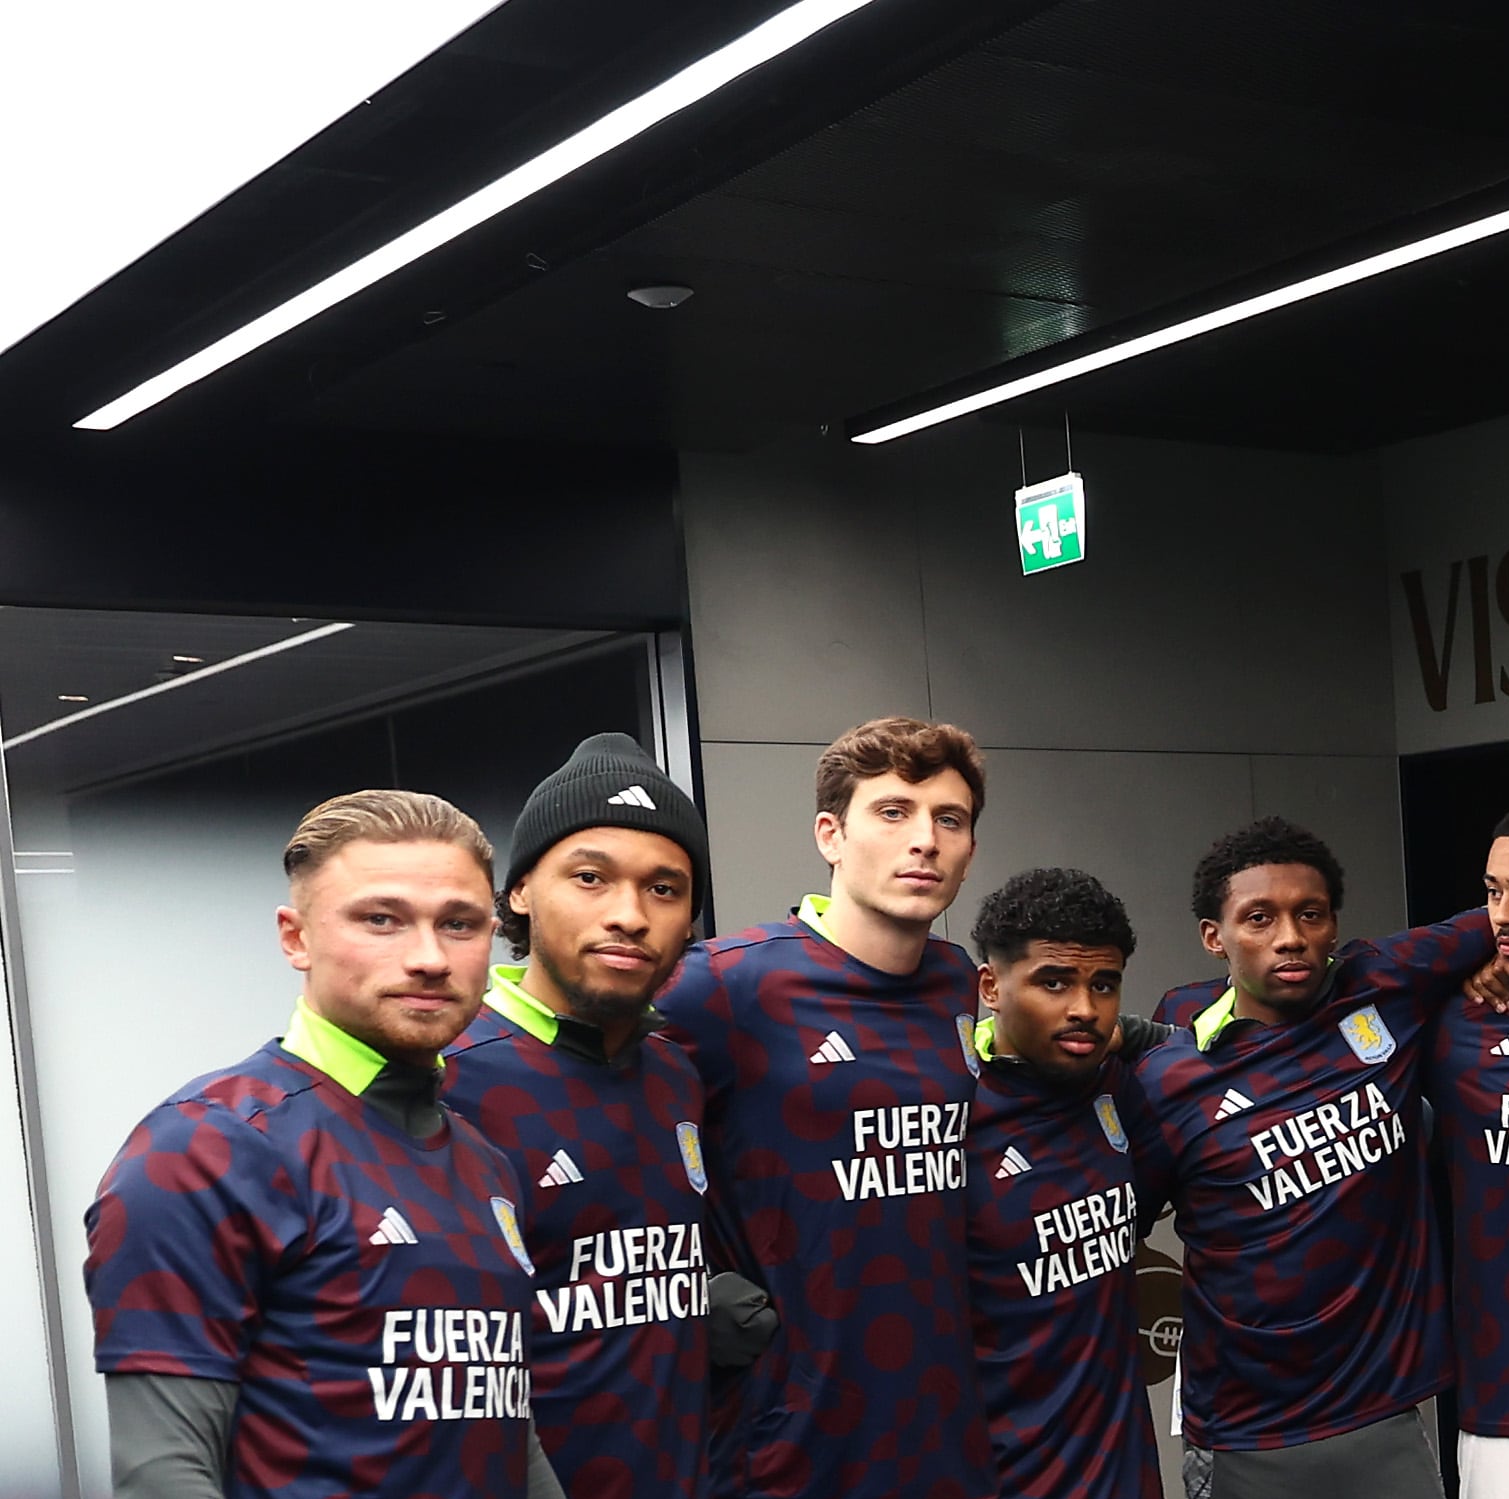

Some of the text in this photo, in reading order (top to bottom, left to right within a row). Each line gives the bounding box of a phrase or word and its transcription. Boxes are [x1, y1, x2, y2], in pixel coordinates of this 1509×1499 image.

[1250, 1082, 1391, 1170] FUERZA
[831, 1147, 967, 1201] VALENCI
[1245, 1112, 1406, 1211] VALENCIA
[1033, 1182, 1137, 1253] FUERZA
[569, 1223, 705, 1282] FUERZA
[536, 1273, 711, 1334] VALENCIA
[381, 1308, 523, 1365] FUERZA
